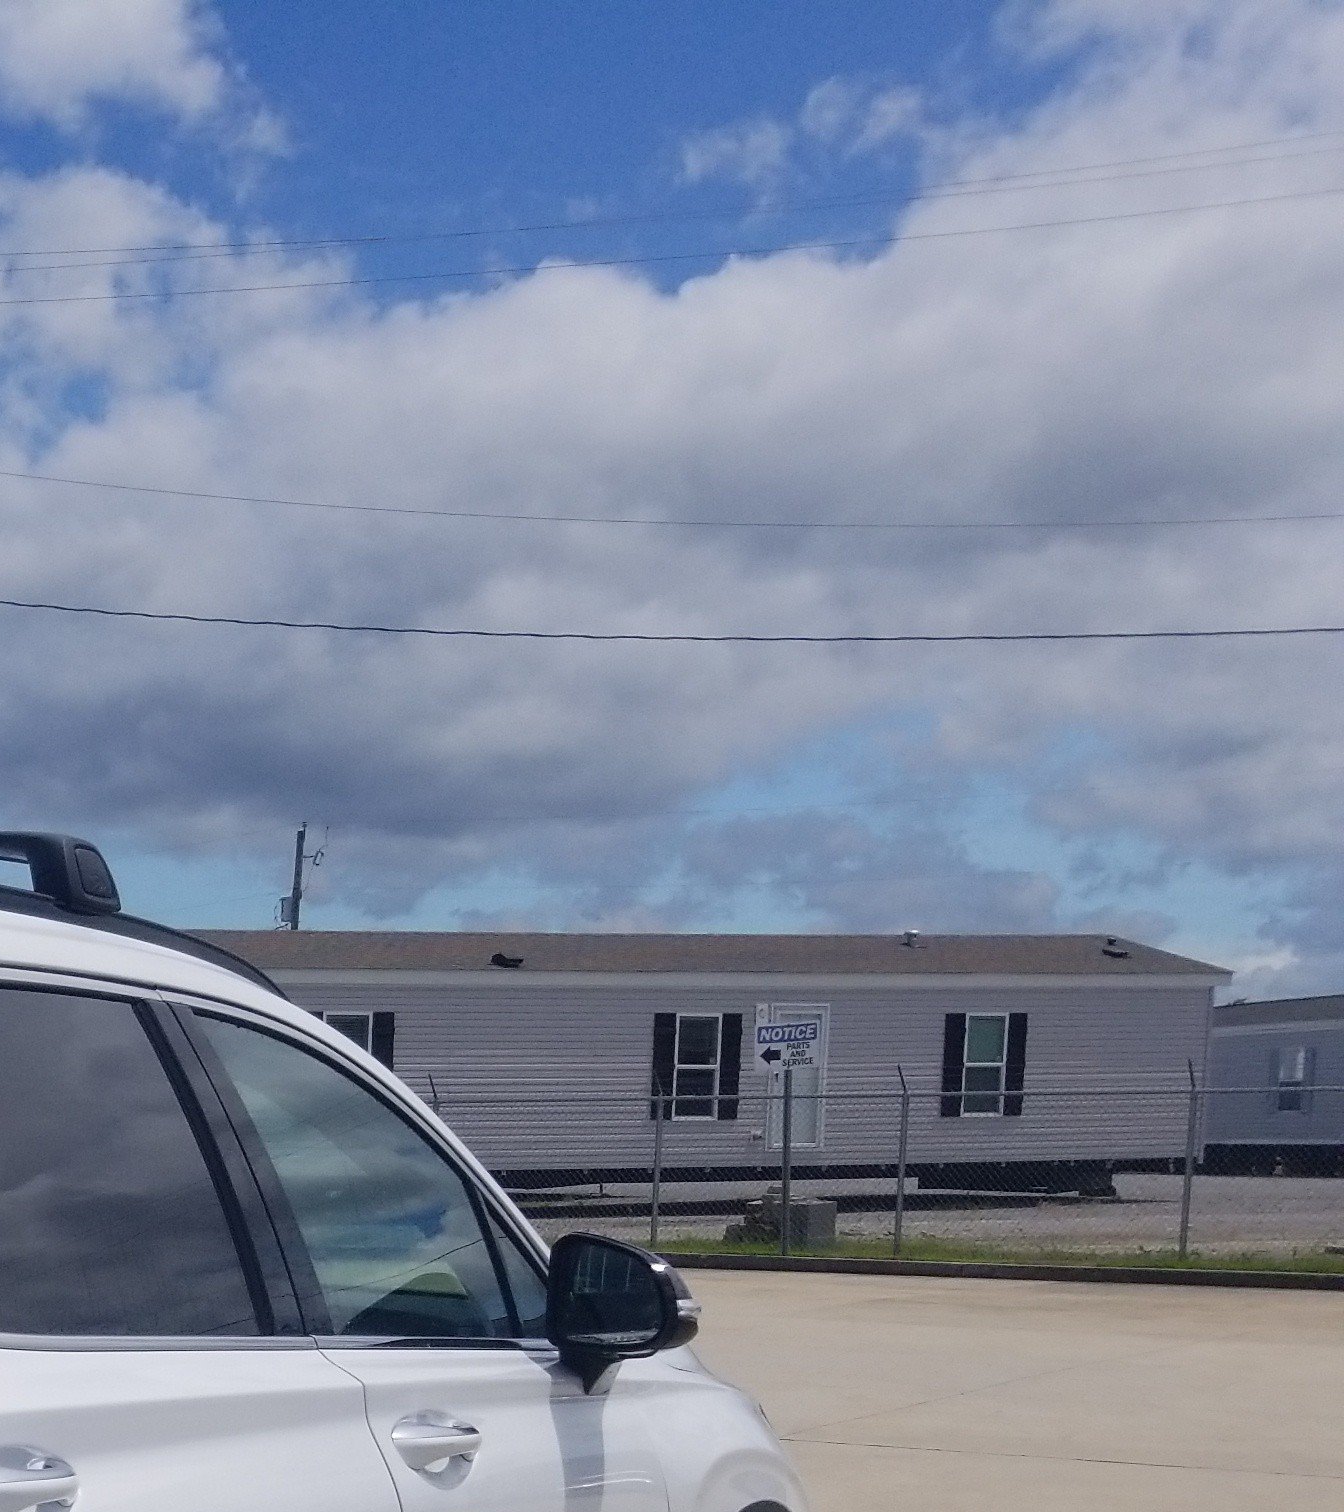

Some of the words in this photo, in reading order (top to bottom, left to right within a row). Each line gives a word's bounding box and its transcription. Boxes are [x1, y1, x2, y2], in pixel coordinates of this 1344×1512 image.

[760, 1025, 815, 1041] NOTICE
[787, 1042, 810, 1051] PARTS
[782, 1057, 814, 1067] SERVICE
